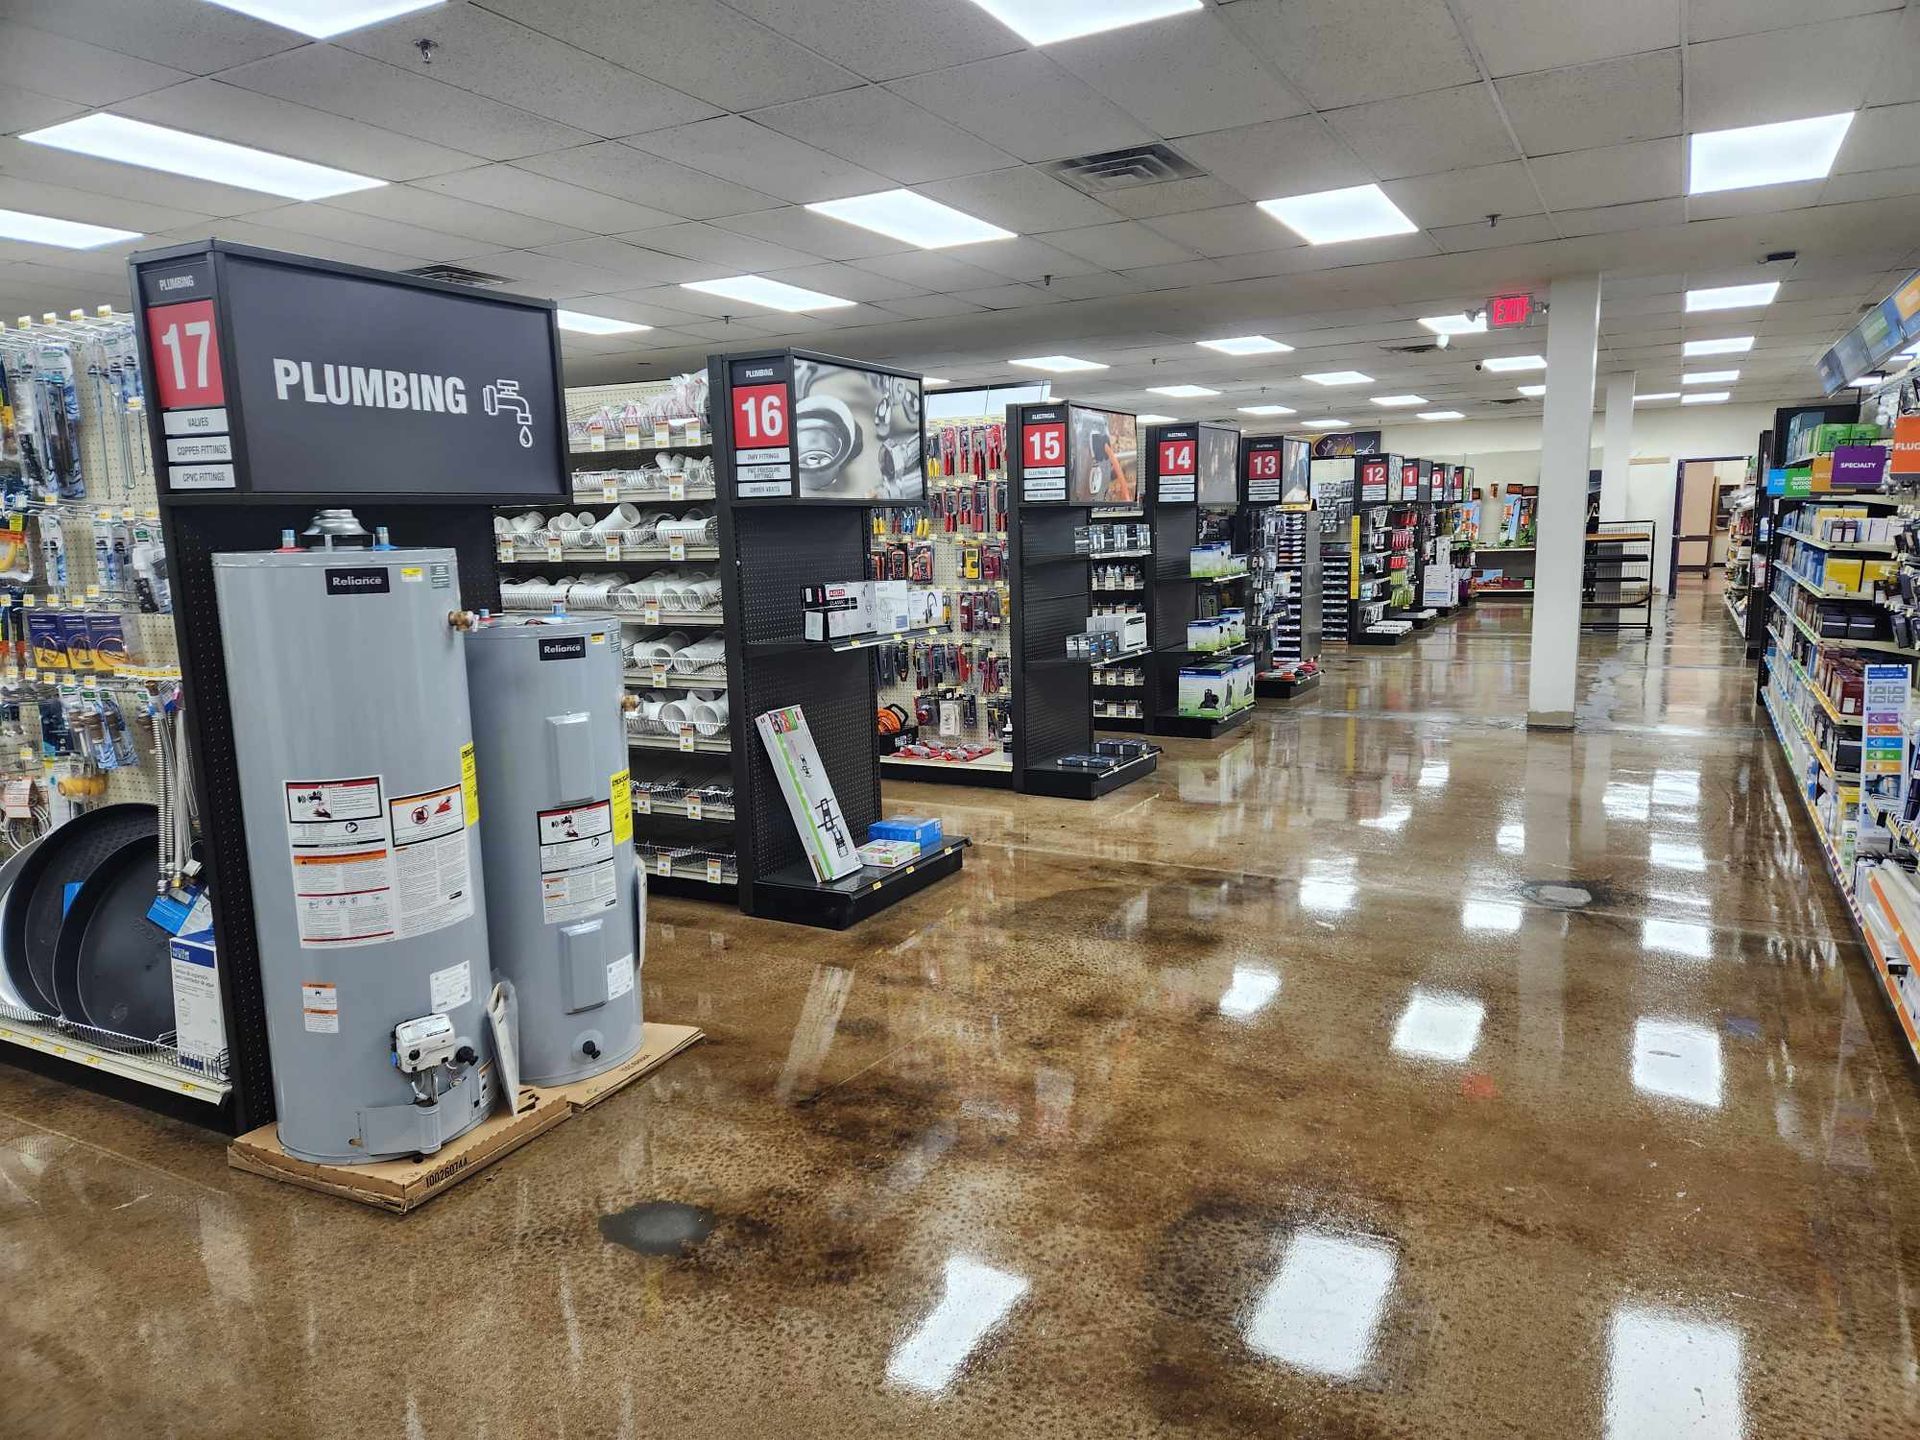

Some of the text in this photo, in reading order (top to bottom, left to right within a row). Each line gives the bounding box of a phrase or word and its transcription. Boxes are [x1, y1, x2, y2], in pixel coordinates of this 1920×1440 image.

[159, 275, 195, 291] PLUMBING
[1493, 296, 1529, 325] EXIT
[161, 321, 210, 390] 17
[745, 368, 774, 378] PLUMBING
[273, 358, 468, 415] PLUMBING
[741, 395, 783, 438] 16
[176, 443, 228, 457] COPPER FITTINGS
[1029, 431, 1061, 461] 15
[1164, 446, 1192, 470] 14
[1253, 455, 1276, 475] 13
[199, 471, 226, 482] FITTINGS
[1366, 467, 1385, 482] 12
[332, 574, 382, 588] Reliance
[544, 643, 581, 655] Reliance
